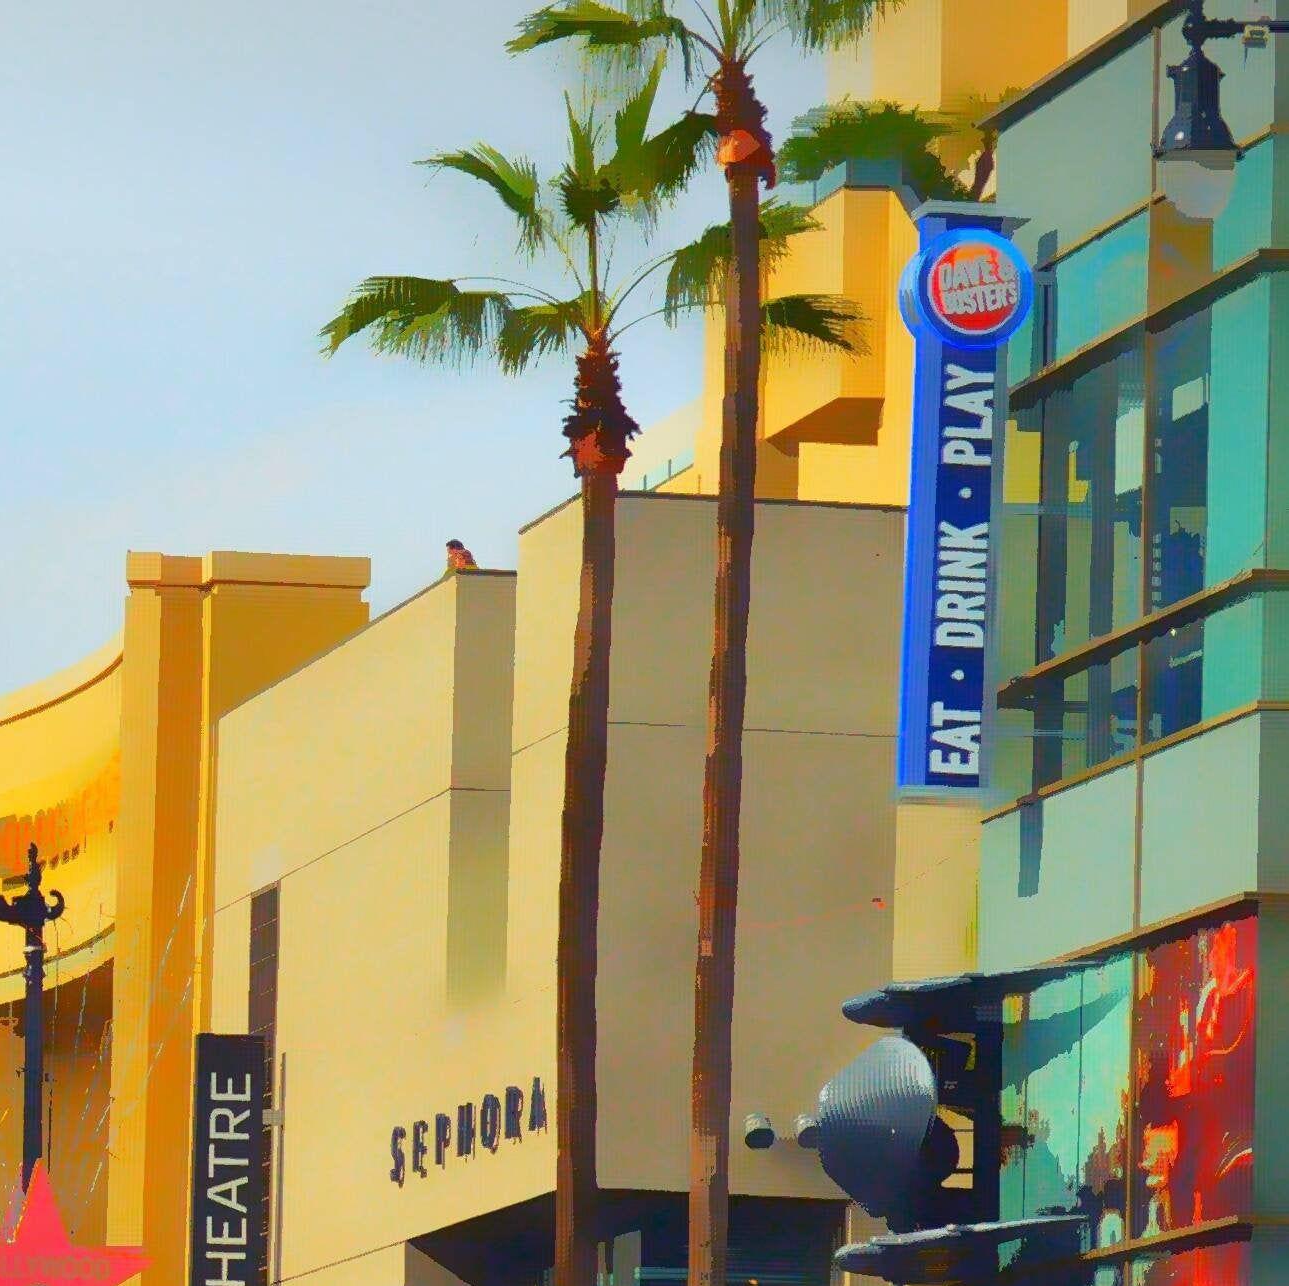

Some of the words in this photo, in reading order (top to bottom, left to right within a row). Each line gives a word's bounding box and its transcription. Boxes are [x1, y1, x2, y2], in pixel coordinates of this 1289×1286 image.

[939, 256, 996, 292] DAVE
[940, 362, 996, 466] PLAY
[935, 520, 990, 650] DRINK
[929, 701, 982, 777] EAT
[390, 1075, 547, 1188] SEPHORA
